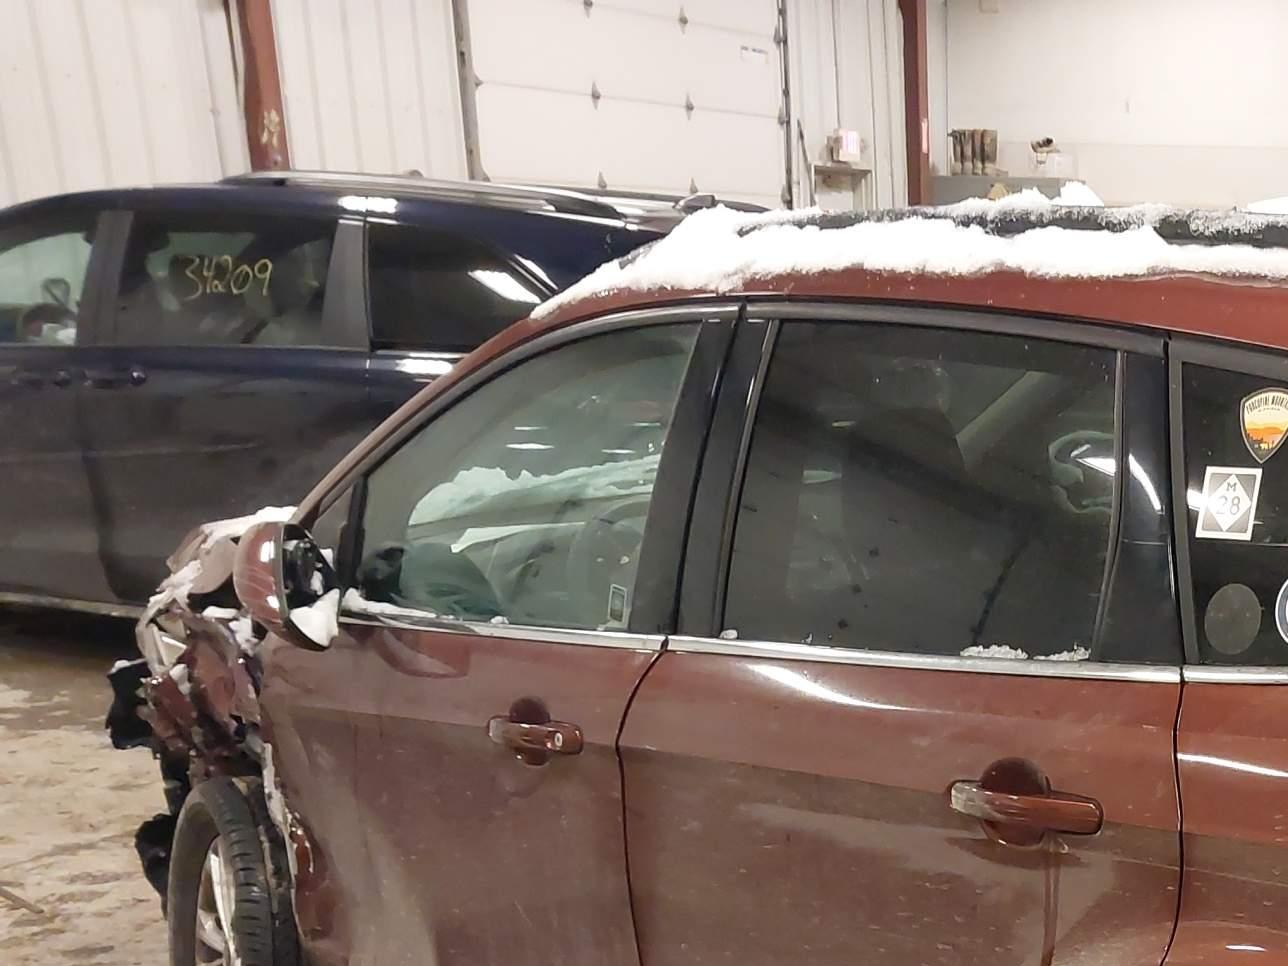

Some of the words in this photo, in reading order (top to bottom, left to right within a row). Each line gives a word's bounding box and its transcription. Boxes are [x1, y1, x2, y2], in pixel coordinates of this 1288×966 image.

[183, 254, 273, 300] 34209
[1226, 482, 1237, 492] M
[1215, 496, 1241, 516] 28
